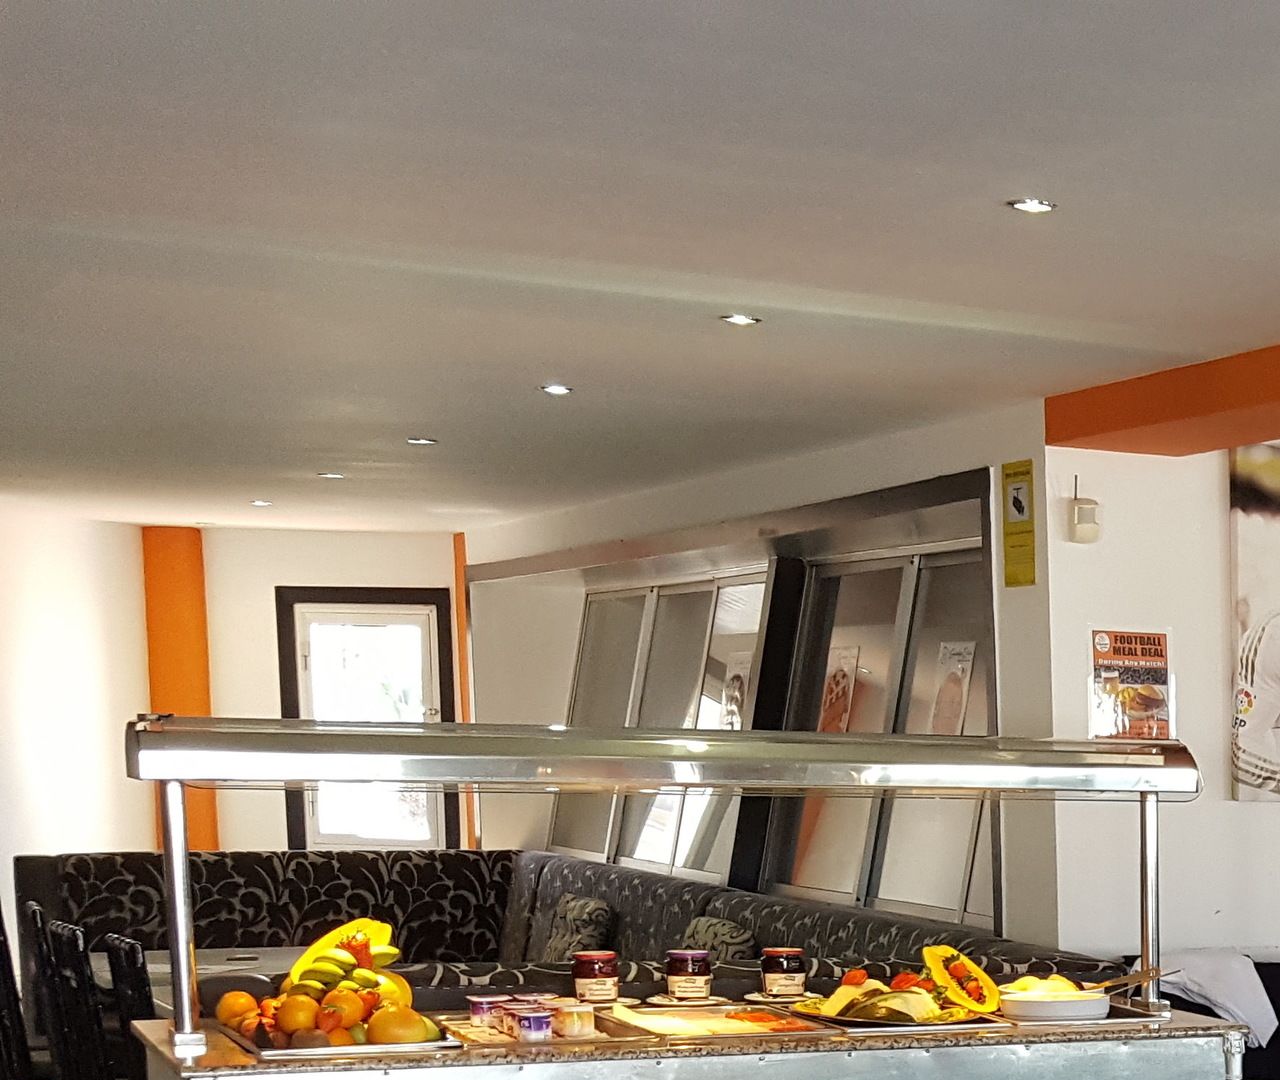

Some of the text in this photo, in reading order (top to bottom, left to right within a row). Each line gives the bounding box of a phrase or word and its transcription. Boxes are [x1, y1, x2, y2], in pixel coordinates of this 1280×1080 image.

[1113, 635, 1162, 646] FOOTBALL
[1112, 646, 1164, 658] MEAL DEAL
